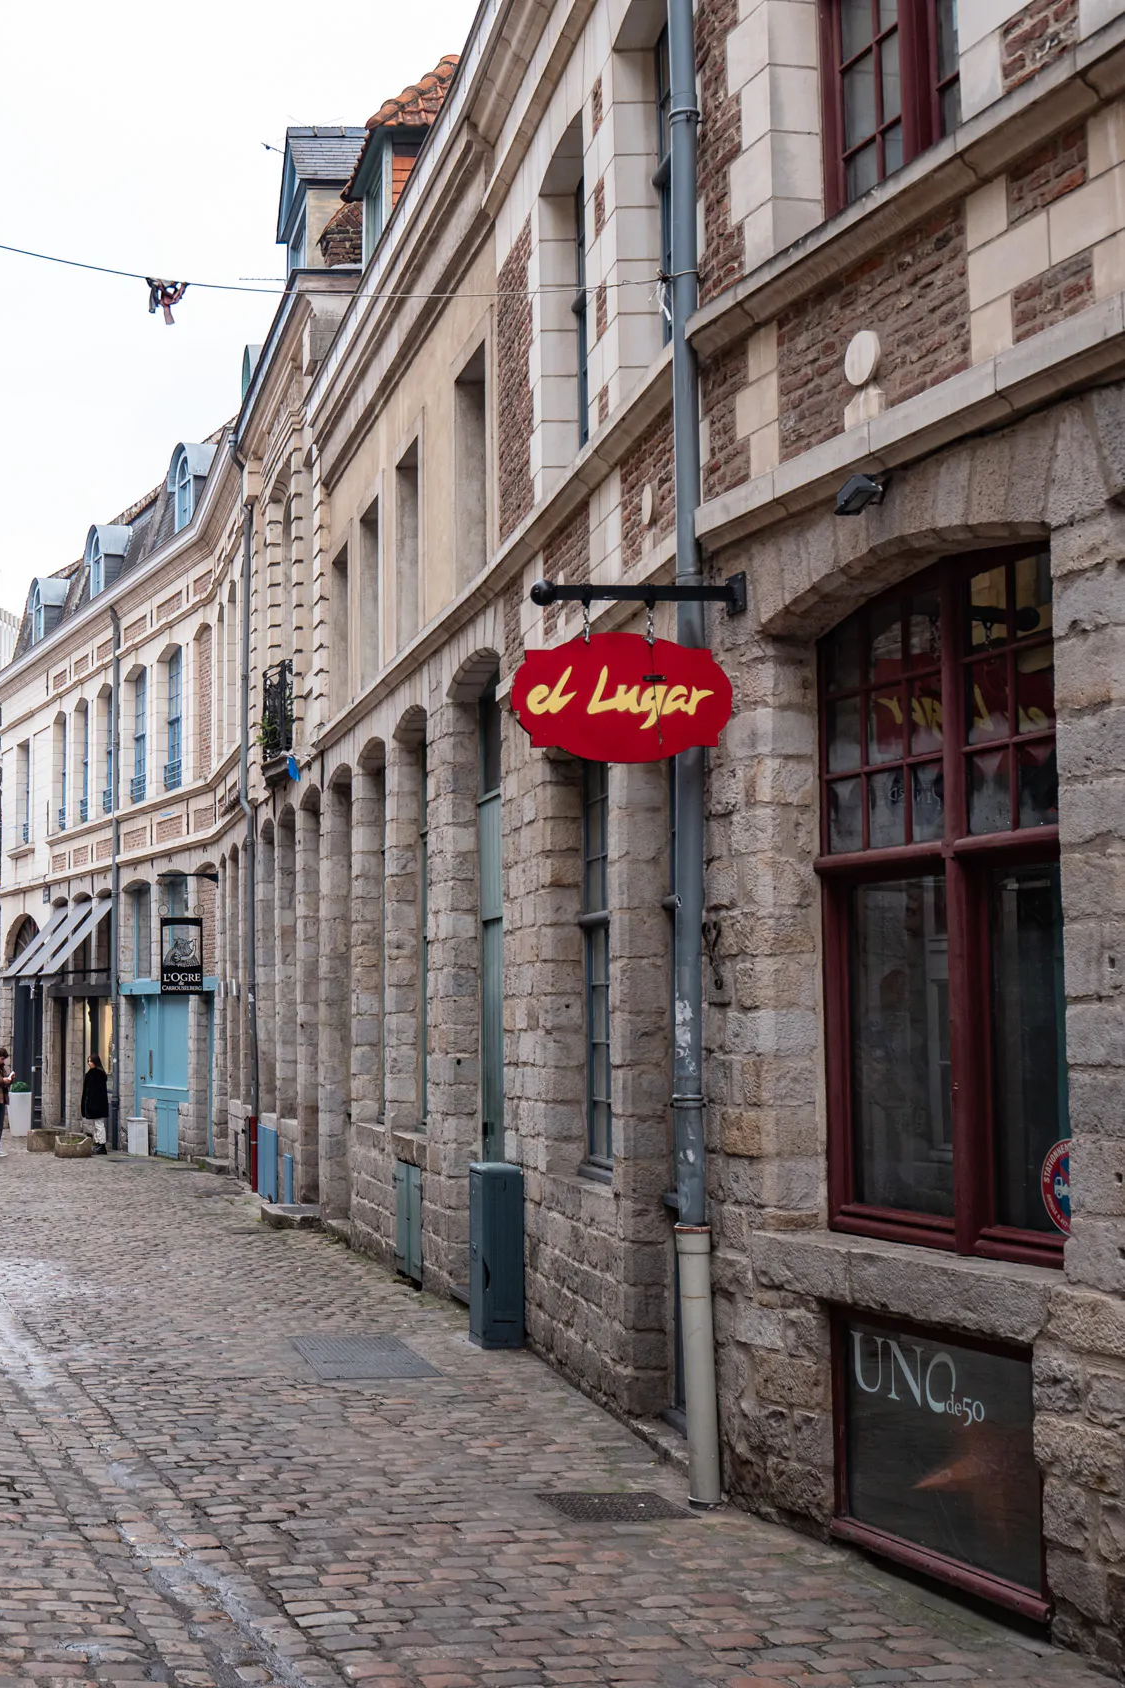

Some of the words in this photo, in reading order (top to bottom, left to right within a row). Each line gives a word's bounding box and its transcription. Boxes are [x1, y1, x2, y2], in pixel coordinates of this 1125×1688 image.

[526, 665, 577, 715] el
[586, 665, 715, 730] Lugar
[163, 972, 202, 982] L'OGRE
[850, 1330, 956, 1413] UNO
